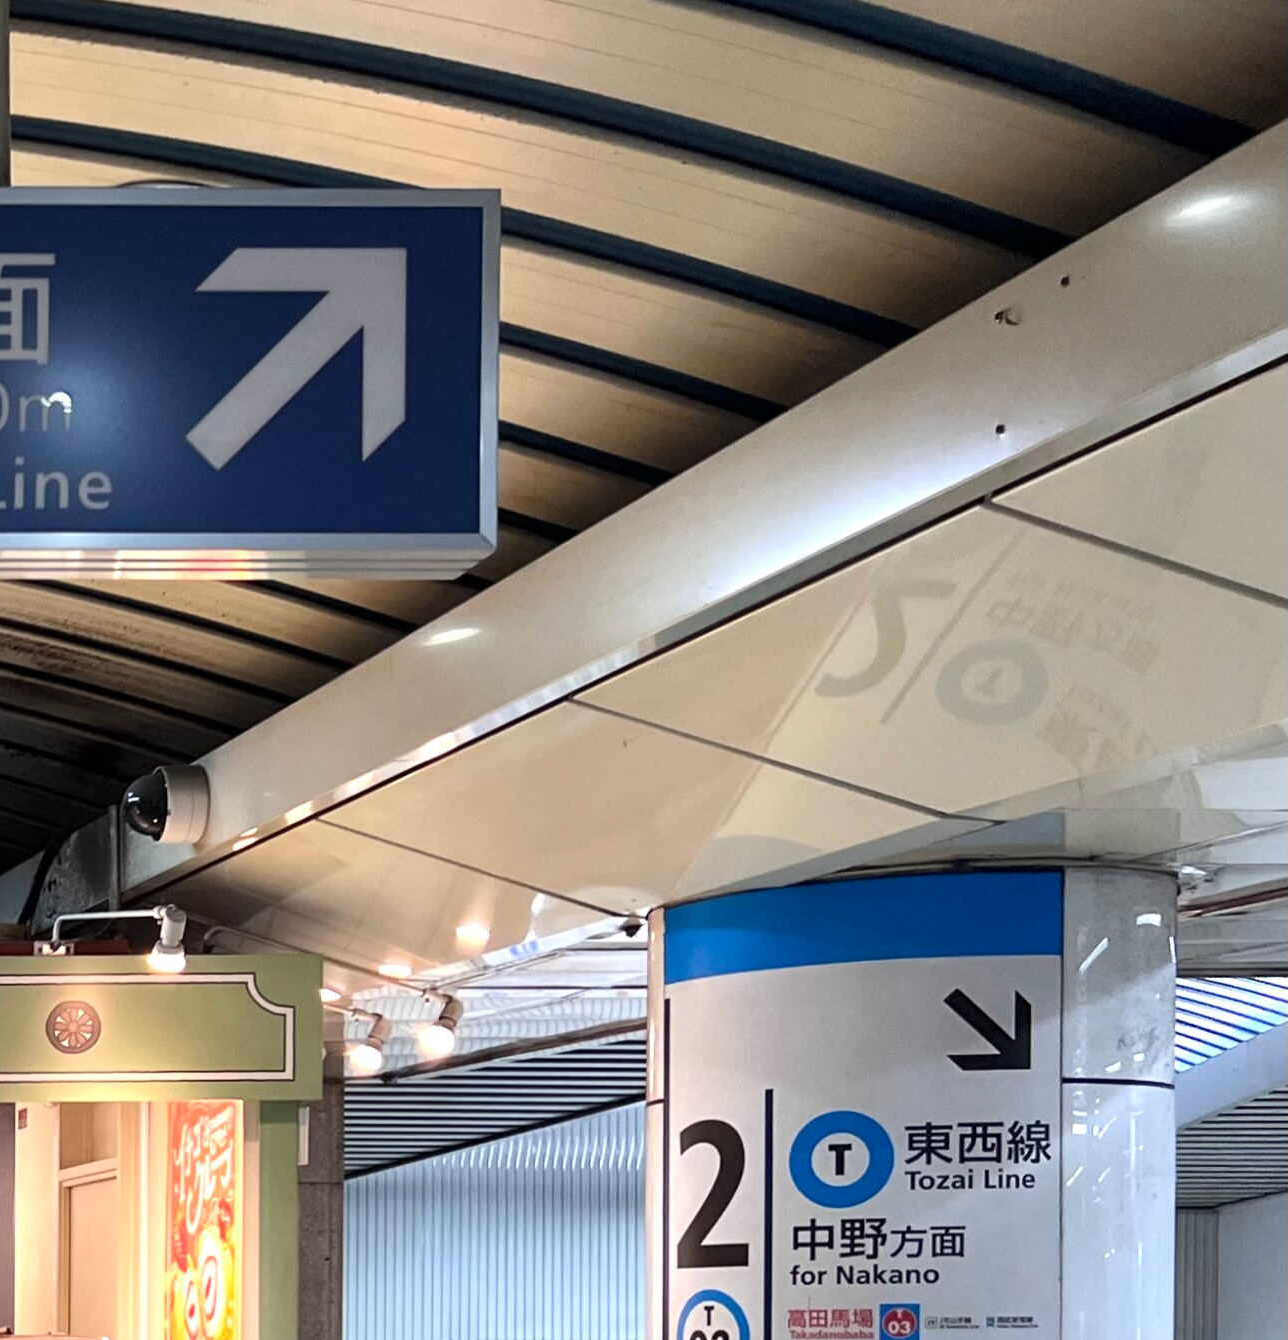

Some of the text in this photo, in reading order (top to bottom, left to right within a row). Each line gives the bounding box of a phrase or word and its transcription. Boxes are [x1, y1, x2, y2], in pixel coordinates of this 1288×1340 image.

[904, 1119, 1052, 1165] 東西線
[828, 1143, 852, 1175] T
[905, 1169, 1035, 1191] Tozai Line
[676, 1119, 749, 1269] 2
[792, 1218, 966, 1261] 中野方面
[790, 1264, 940, 1286] for Nakano
[704, 1306, 715, 1327] T
[787, 1309, 873, 1329] 高田馬場
[888, 1321, 911, 1334] 03
[789, 1330, 874, 1339] Takadanobaba
